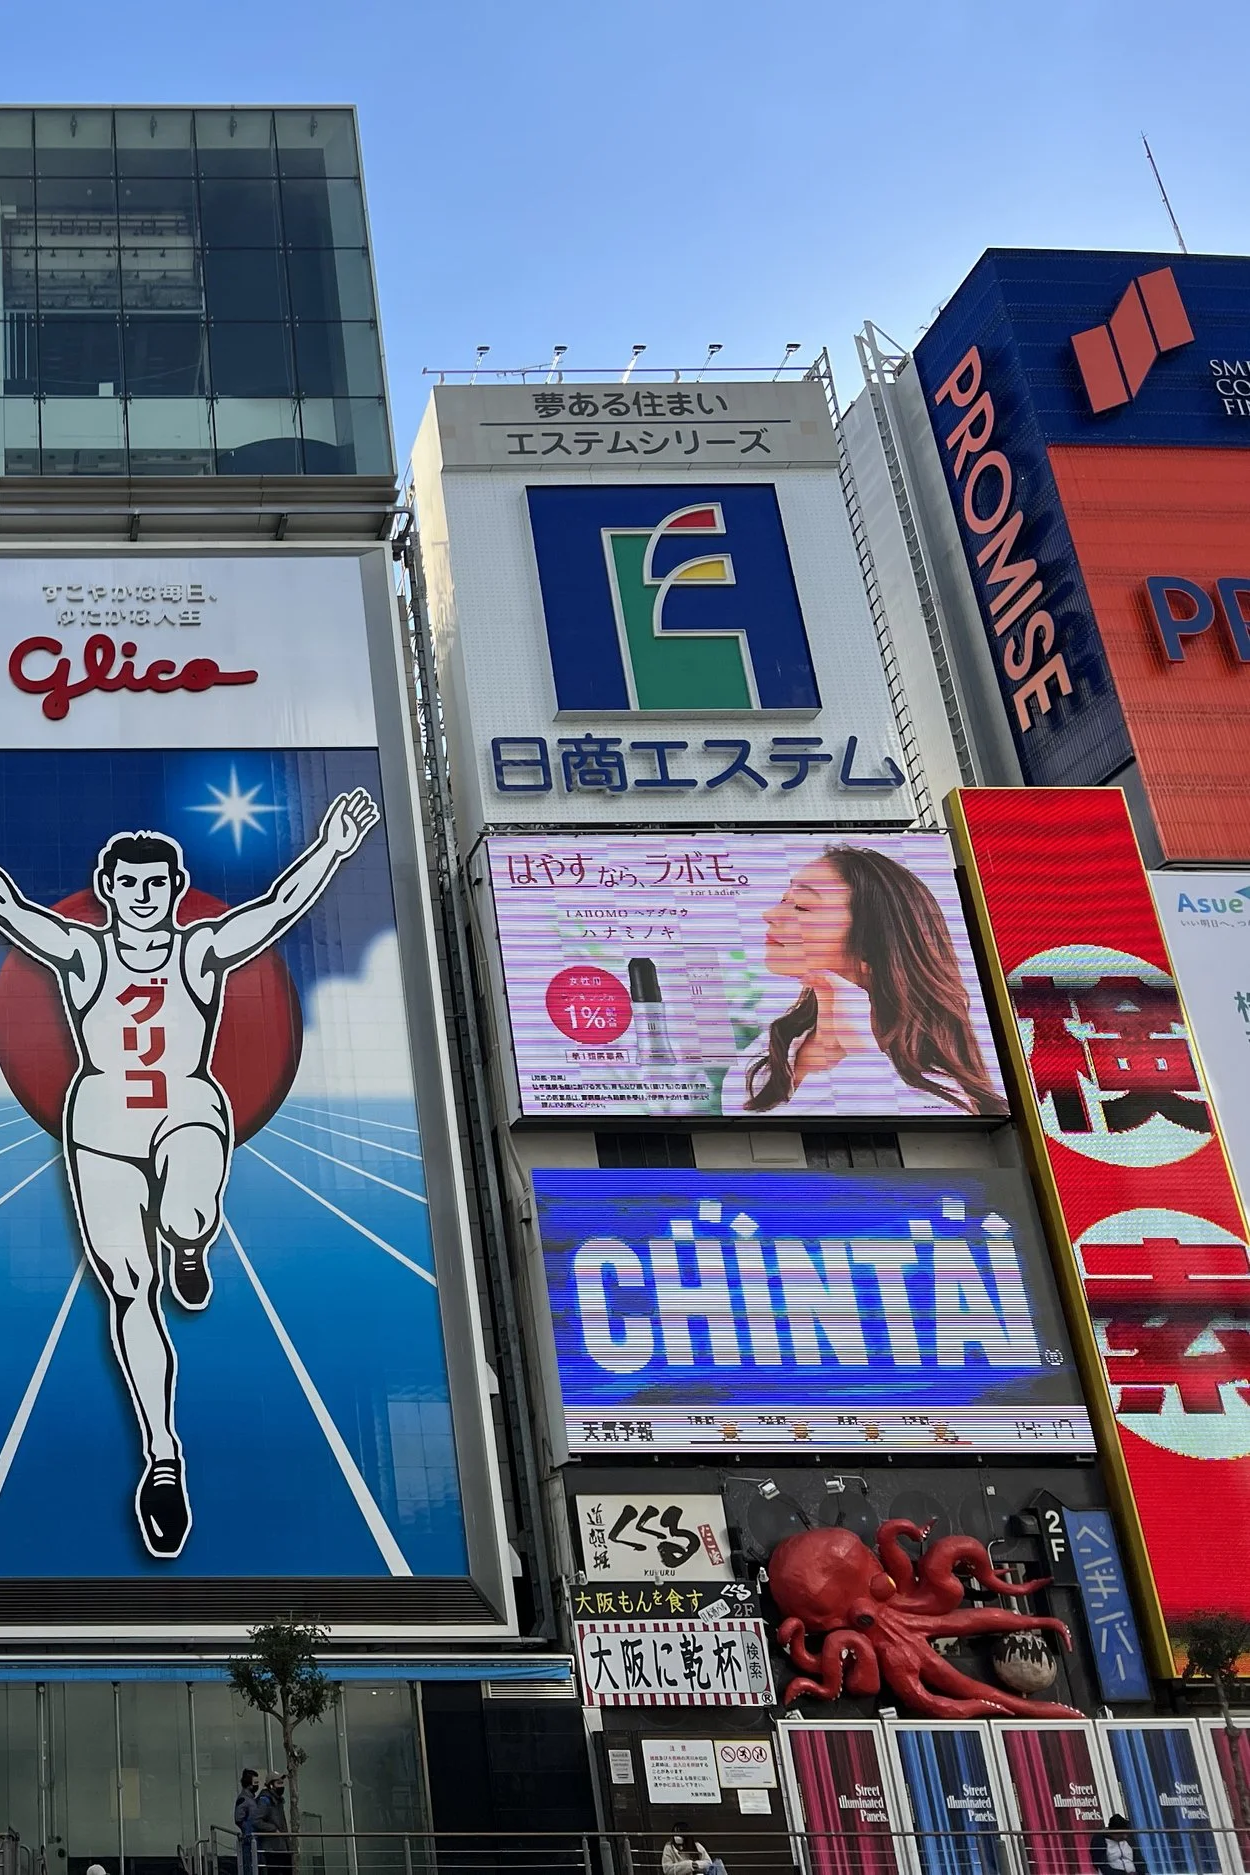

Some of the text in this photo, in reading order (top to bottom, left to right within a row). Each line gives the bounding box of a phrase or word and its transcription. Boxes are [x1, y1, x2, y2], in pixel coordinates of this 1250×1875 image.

[532, 390, 729, 418] 夢ある住まい
[506, 427, 771, 456] エステムシリーズ
[934, 344, 1074, 734] PROMISE
[42, 583, 218, 603] すこやかな毎日、
[57, 608, 202, 627] ゆたかな人生
[8, 633, 259, 720] Glico
[490, 732, 906, 795] 日商エステム
[1177, 892, 1244, 914] Asue
[563, 1005, 607, 1030] 1%
[115, 977, 169, 1110] グリコ
[582, 1420, 655, 1443] 天気予報
[607, 1504, 701, 1569] くくる
[1043, 1509, 1068, 1563] 2F
[574, 1588, 704, 1616] 大阪もんを食す
[719, 1584, 752, 1602] くくる
[733, 1603, 756, 1618] 2F
[589, 1632, 743, 1692] 大阪に乾杯
[745, 1641, 764, 1680] 検索
[855, 1783, 881, 1797] Street
[962, 1783, 987, 1797] Street
[1069, 1782, 1094, 1796] Street
[1174, 1781, 1199, 1795] Street
[839, 1793, 885, 1810] Illuminated
[947, 1794, 992, 1810] Illuminated
[1053, 1793, 1099, 1808] Illuminated
[1159, 1792, 1204, 1807] Illuminated
[860, 1809, 891, 1823] Panels.
[968, 1808, 998, 1823] Panels.
[1074, 1807, 1103, 1821] Panels.
[1181, 1805, 1210, 1820] Panels.
